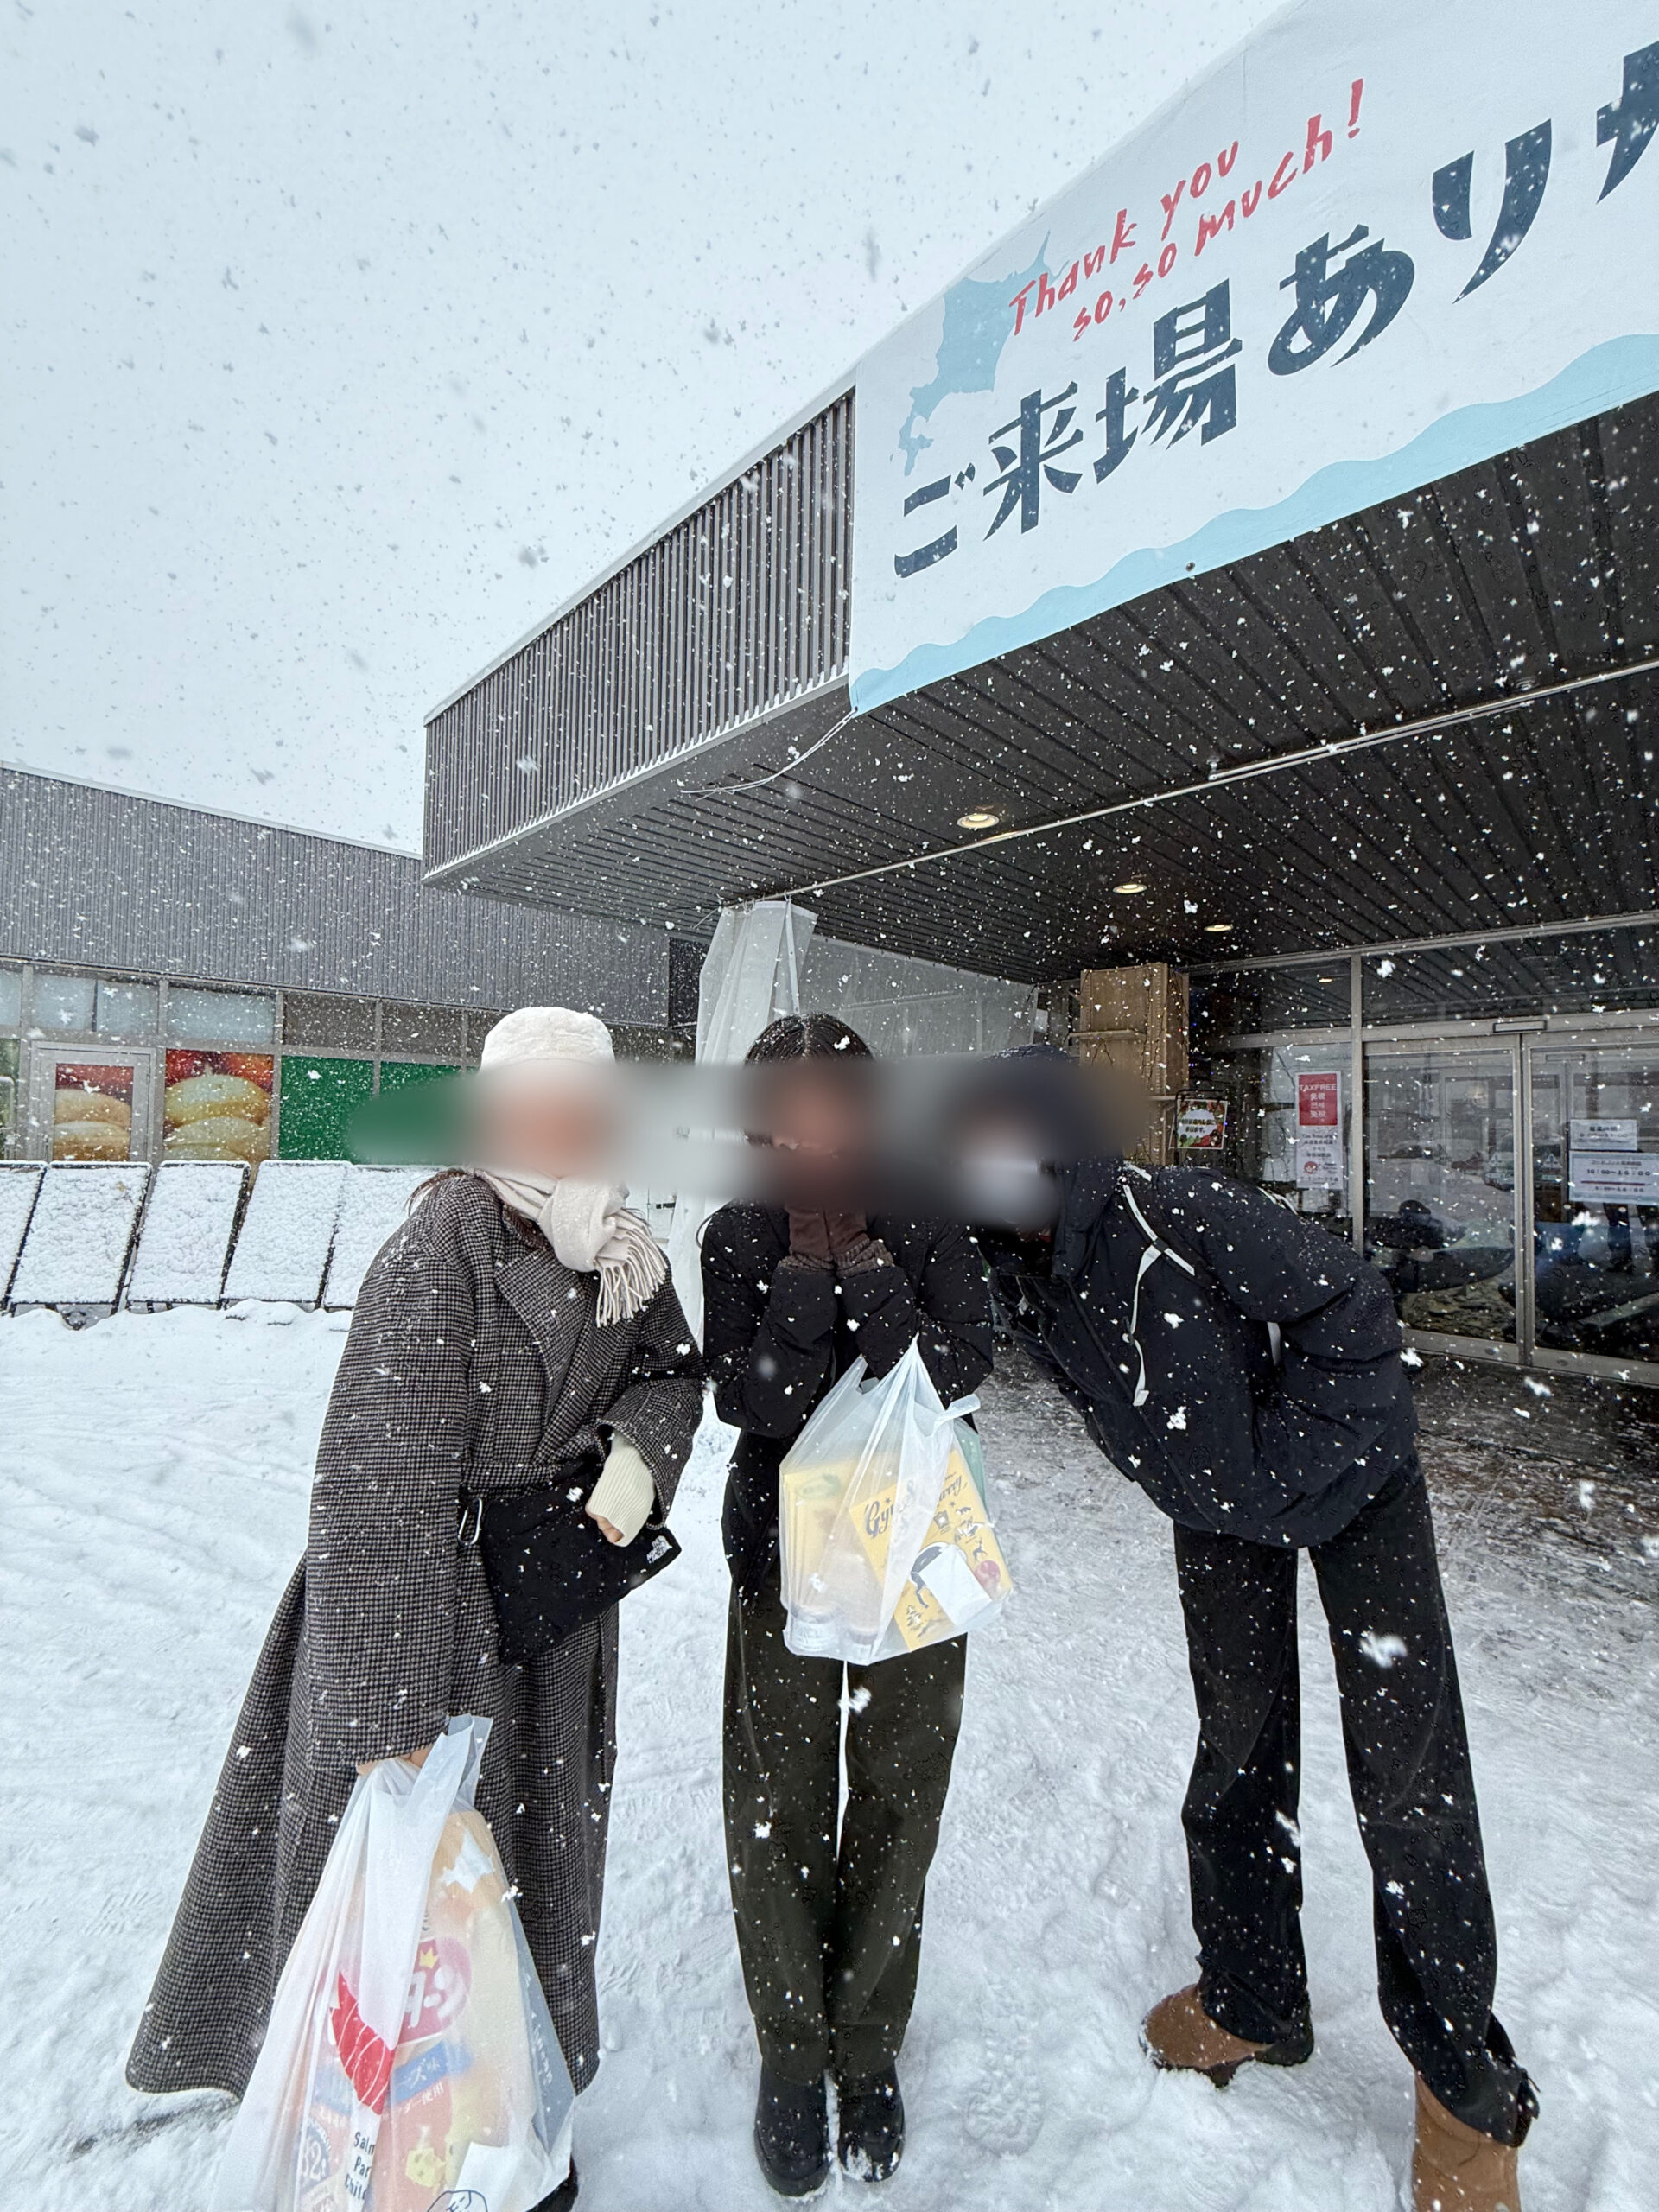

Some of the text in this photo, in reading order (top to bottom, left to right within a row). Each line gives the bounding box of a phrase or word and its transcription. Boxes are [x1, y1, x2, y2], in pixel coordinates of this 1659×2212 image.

[1008, 141, 1239, 335] Thank you
[1194, 78, 1364, 257] much!
